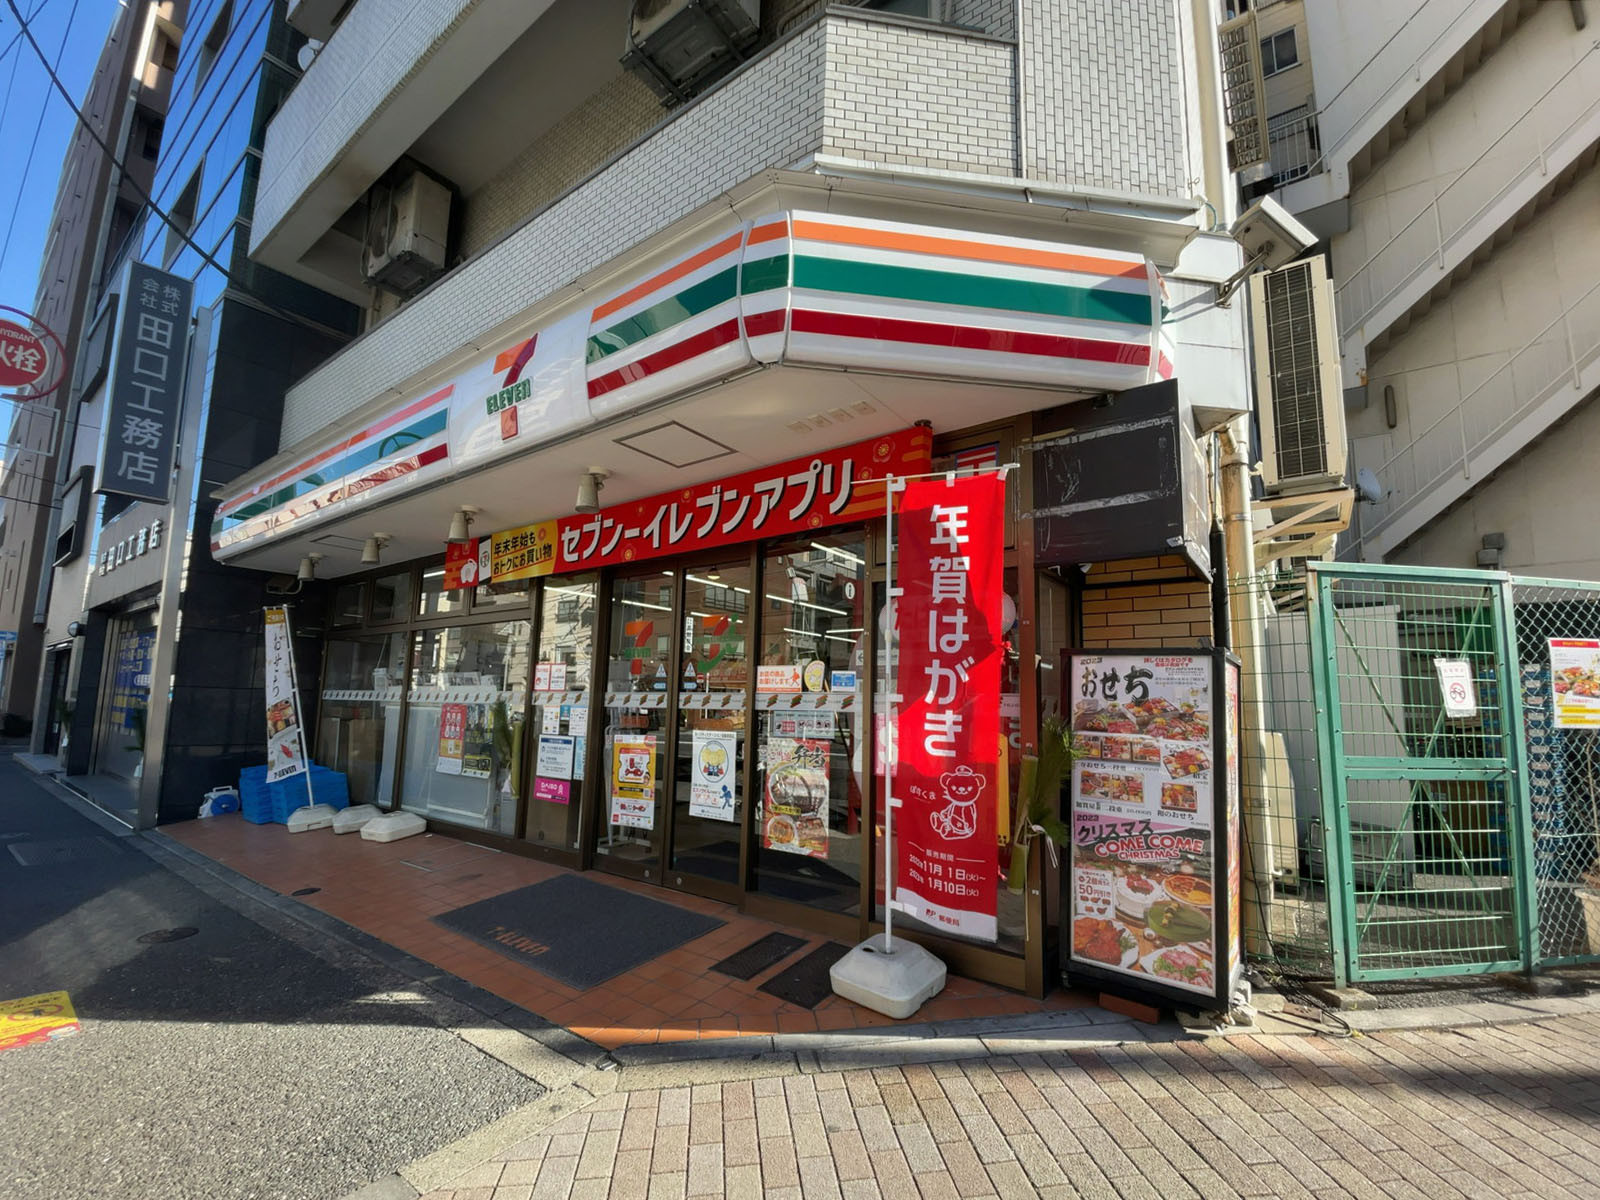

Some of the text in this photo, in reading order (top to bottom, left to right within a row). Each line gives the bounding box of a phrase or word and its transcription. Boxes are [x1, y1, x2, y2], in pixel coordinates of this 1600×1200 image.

[117, 312, 174, 485] 田口工務店
[924, 504, 975, 757] 年賀はがき
[1081, 665, 1153, 706] おせち
[1077, 818, 1154, 843] クリスマス
[1095, 834, 1205, 857] COME COME
[1118, 849, 1181, 861] CHRISTMAS
